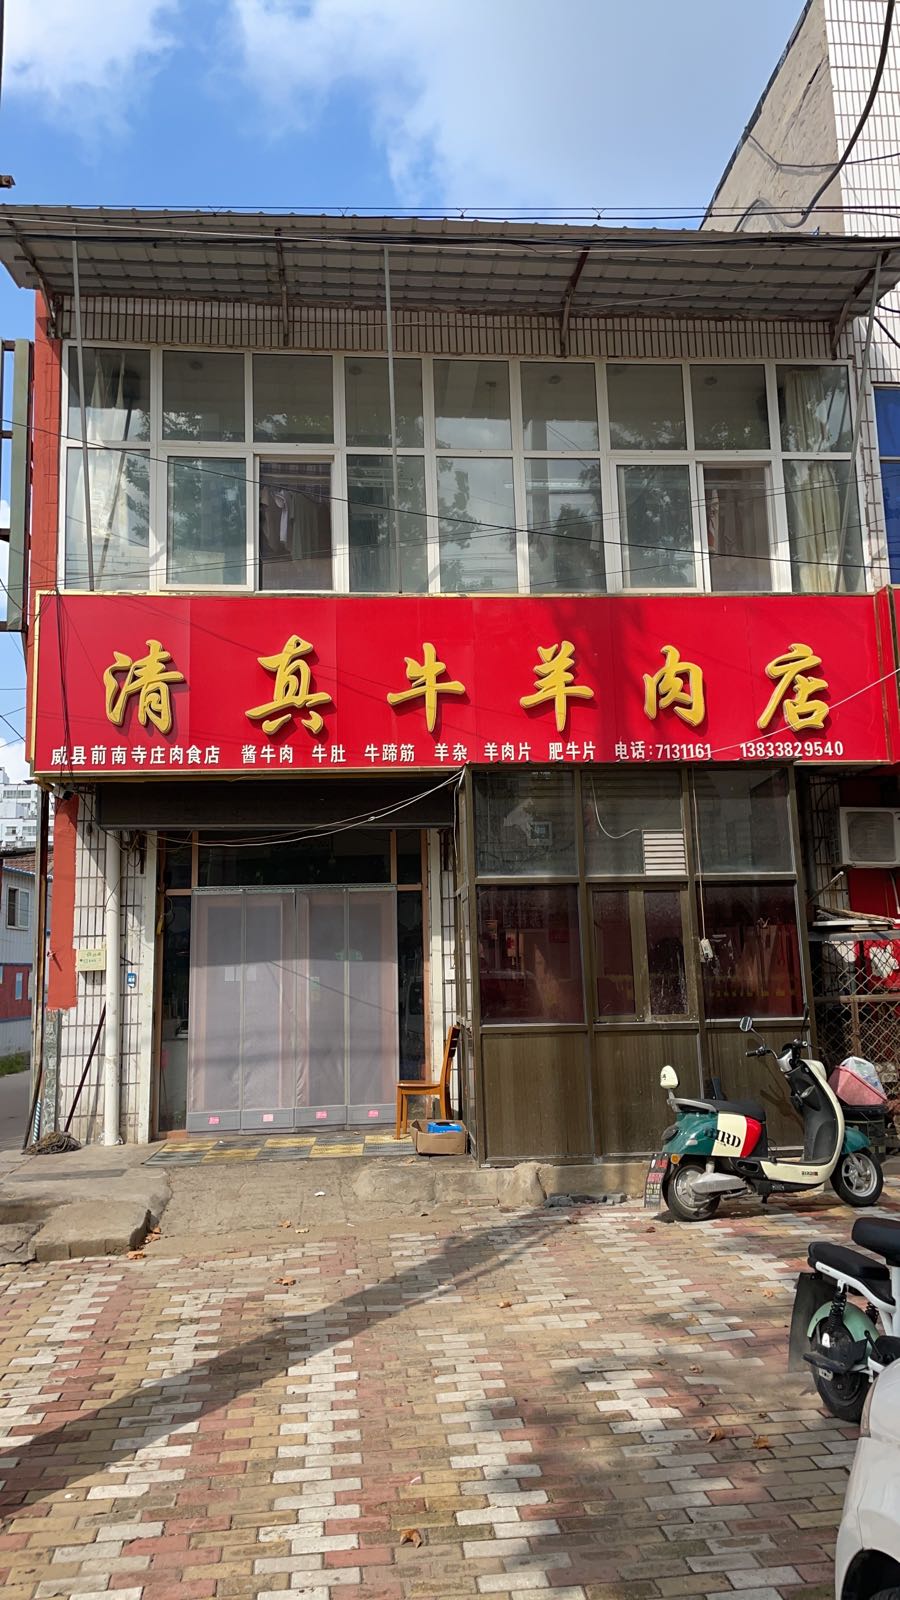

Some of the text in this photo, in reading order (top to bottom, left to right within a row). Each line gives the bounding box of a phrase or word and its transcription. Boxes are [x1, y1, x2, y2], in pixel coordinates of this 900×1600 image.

[103, 634, 830, 734] 清真牛羊肉店
[50, 744, 220, 766] 威县前南寺庄肉食店
[240, 743, 294, 764] 酱牛肉
[311, 743, 347, 763] 牛肚
[364, 742, 416, 763] 牛蹄筋
[434, 741, 469, 762] 羊杂
[483, 741, 532, 761] 羊肉片
[548, 741, 597, 760] 肥牛片
[739, 740, 845, 758] 13833829540
[703, 1126, 742, 1148] BIRD
